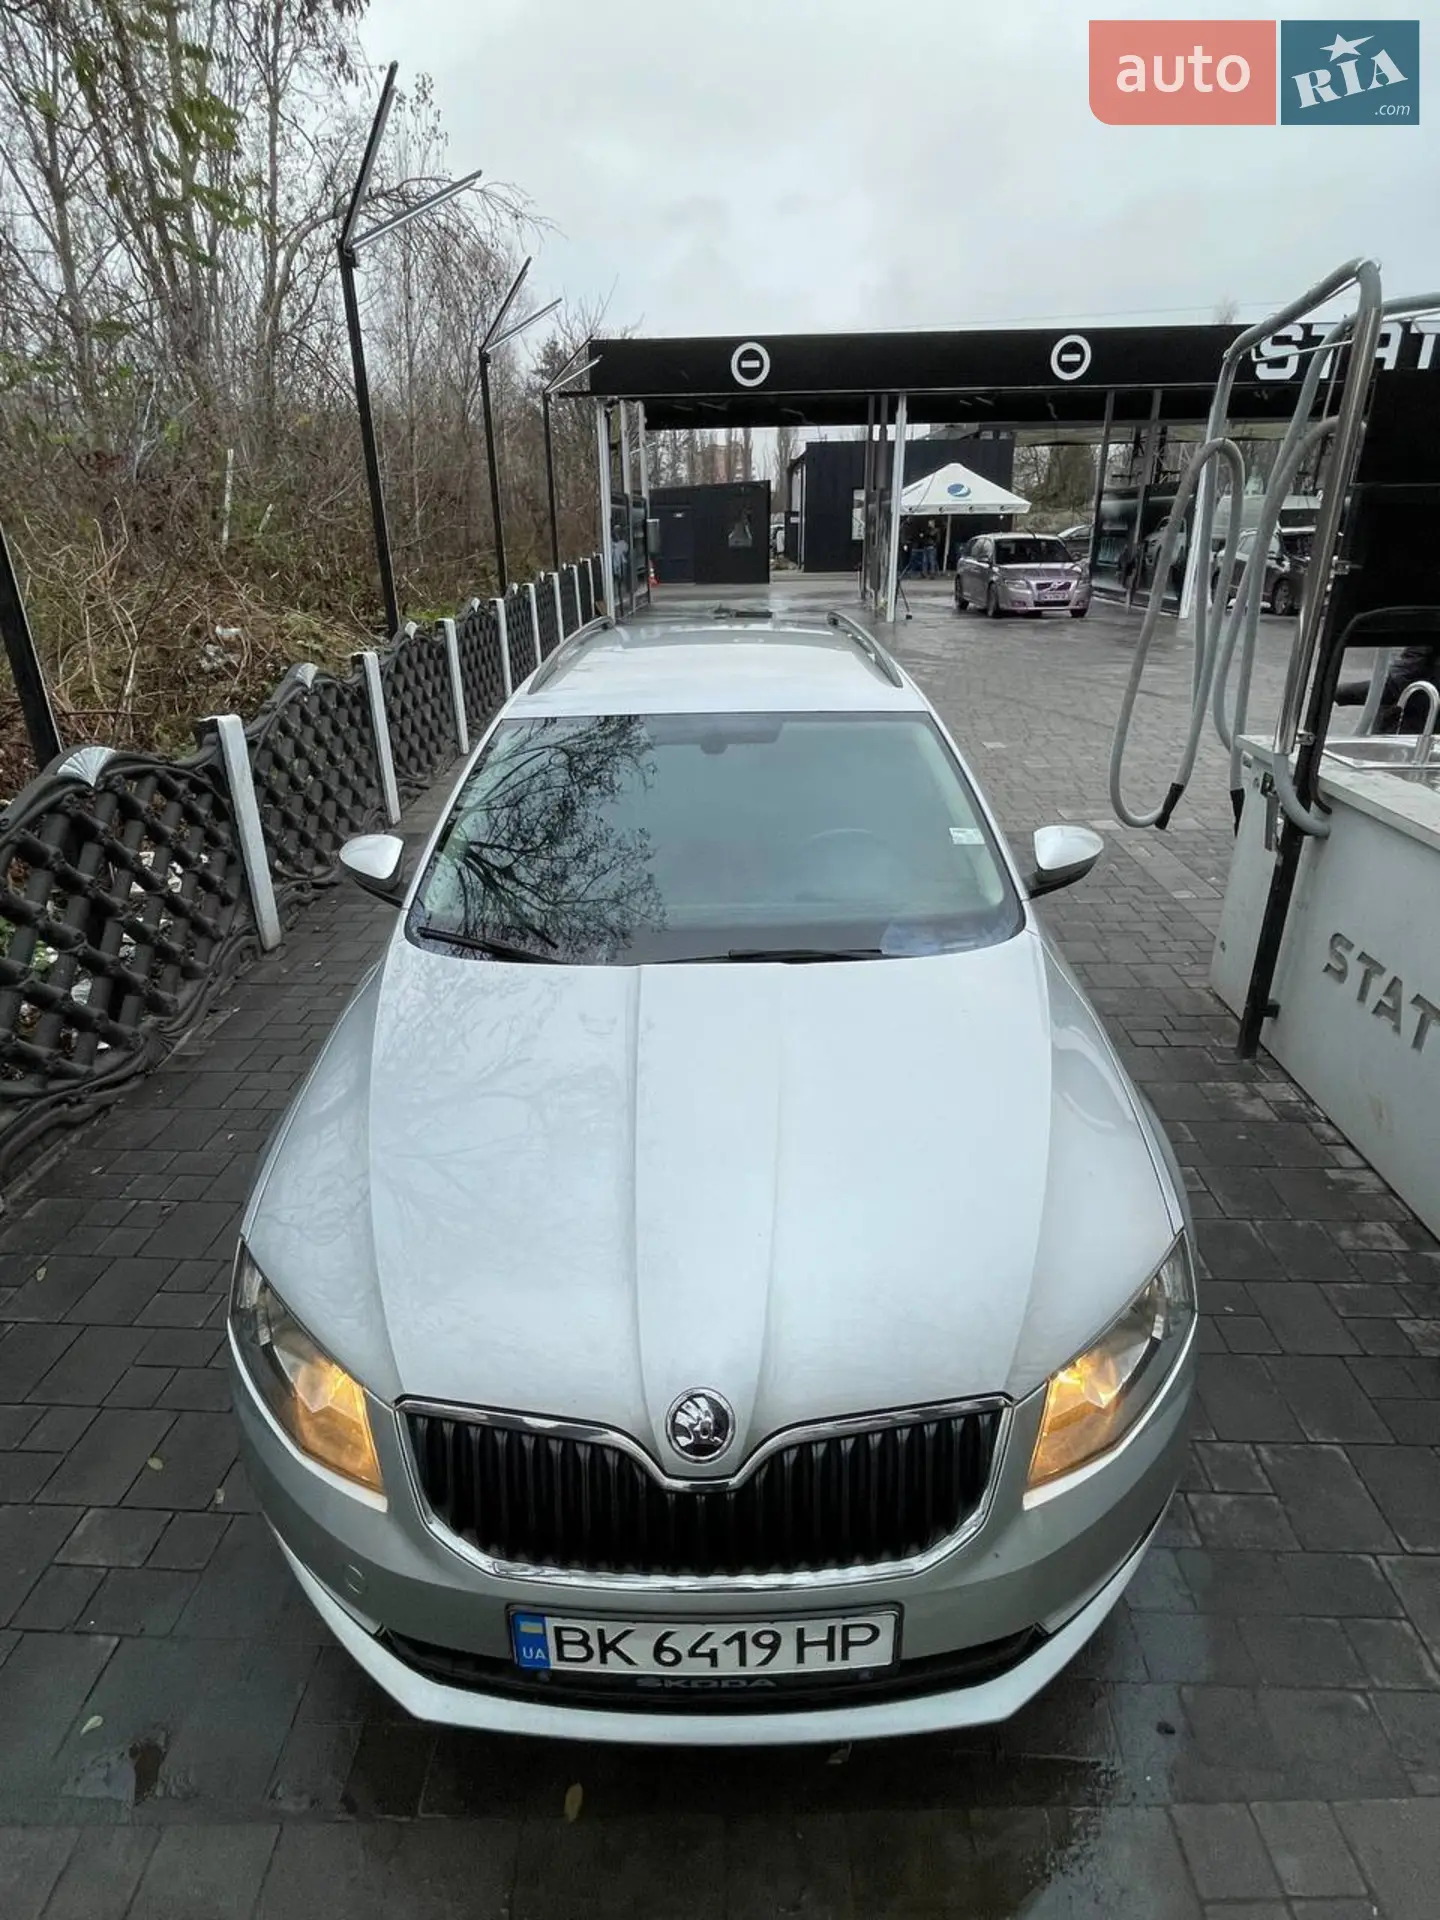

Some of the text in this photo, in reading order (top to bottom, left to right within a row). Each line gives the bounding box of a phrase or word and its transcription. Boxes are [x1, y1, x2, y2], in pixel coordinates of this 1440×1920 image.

[522, 1647, 547, 1660] UA
[553, 1622, 881, 1668] BK 6419 HP
